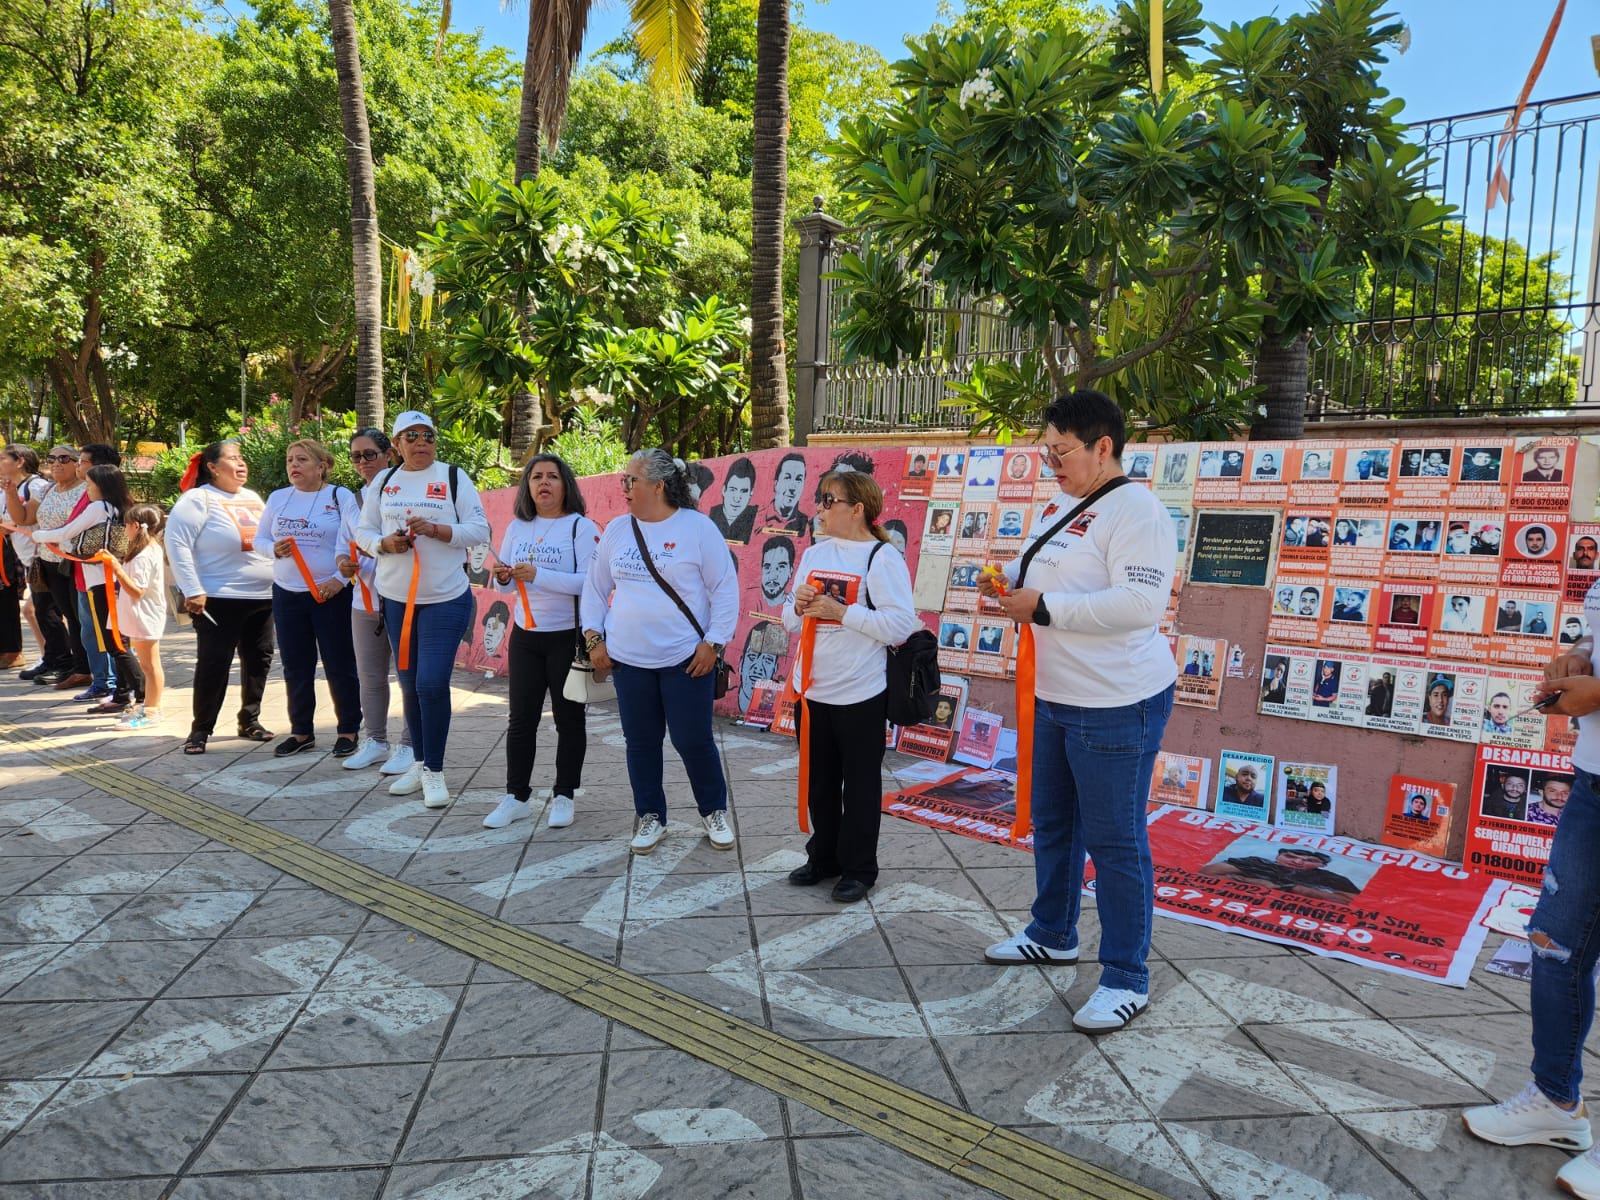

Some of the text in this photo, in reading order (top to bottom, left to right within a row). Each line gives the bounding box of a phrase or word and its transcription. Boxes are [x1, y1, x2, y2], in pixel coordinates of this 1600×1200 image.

[1509, 513, 1567, 523] DESAPARECIDO
[1124, 565, 1165, 578] DEFENSORAS
[1127, 571, 1162, 583] DERECHOS
[1128, 577, 1160, 589] HUMANOS
[1438, 586, 1496, 597] DESAPARECIDO
[1499, 590, 1559, 601] DESAPARECIDO
[1222, 752, 1273, 764] DESAPARECIDO
[1482, 746, 1574, 770] DESAPAREC
[1400, 783, 1440, 797] JUSTICIA
[913, 808, 957, 823] 800
[954, 817, 1012, 839] 6703
[1488, 821, 1517, 831] FEBRERO
[1474, 827, 1510, 841] SERGIO
[1180, 811, 1470, 881] DESAPARECIDO
[1491, 841, 1551, 860] OJEDA QUIN
[1153, 882, 1204, 901] 67
[1209, 897, 1273, 918] 157
[1278, 914, 1374, 944] 1930
[1270, 899, 1349, 925] RANGEL
